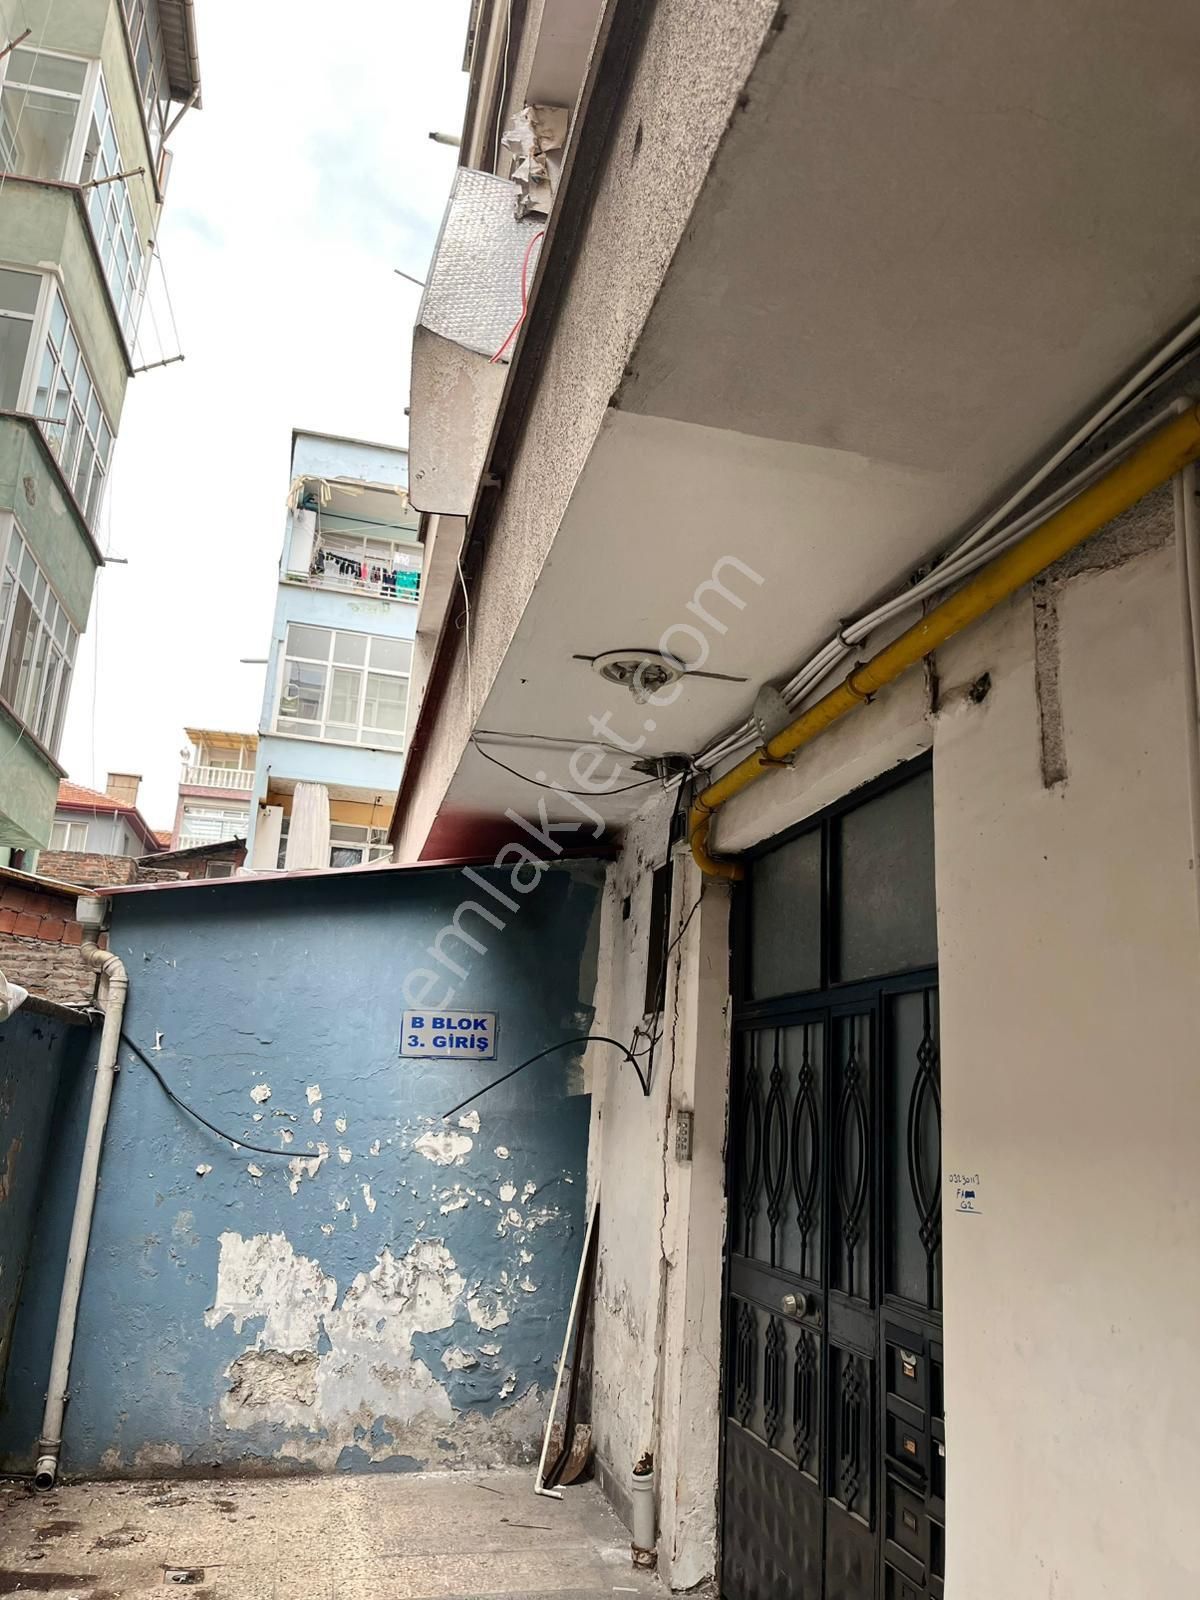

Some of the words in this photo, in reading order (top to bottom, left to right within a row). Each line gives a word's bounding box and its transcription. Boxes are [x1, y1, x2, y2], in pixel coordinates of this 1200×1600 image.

[411, 1016, 425, 1029] B
[432, 1017, 487, 1031] BLOK
[407, 1035, 425, 1048] 3.
[433, 1033, 489, 1052] GİRİŞ
